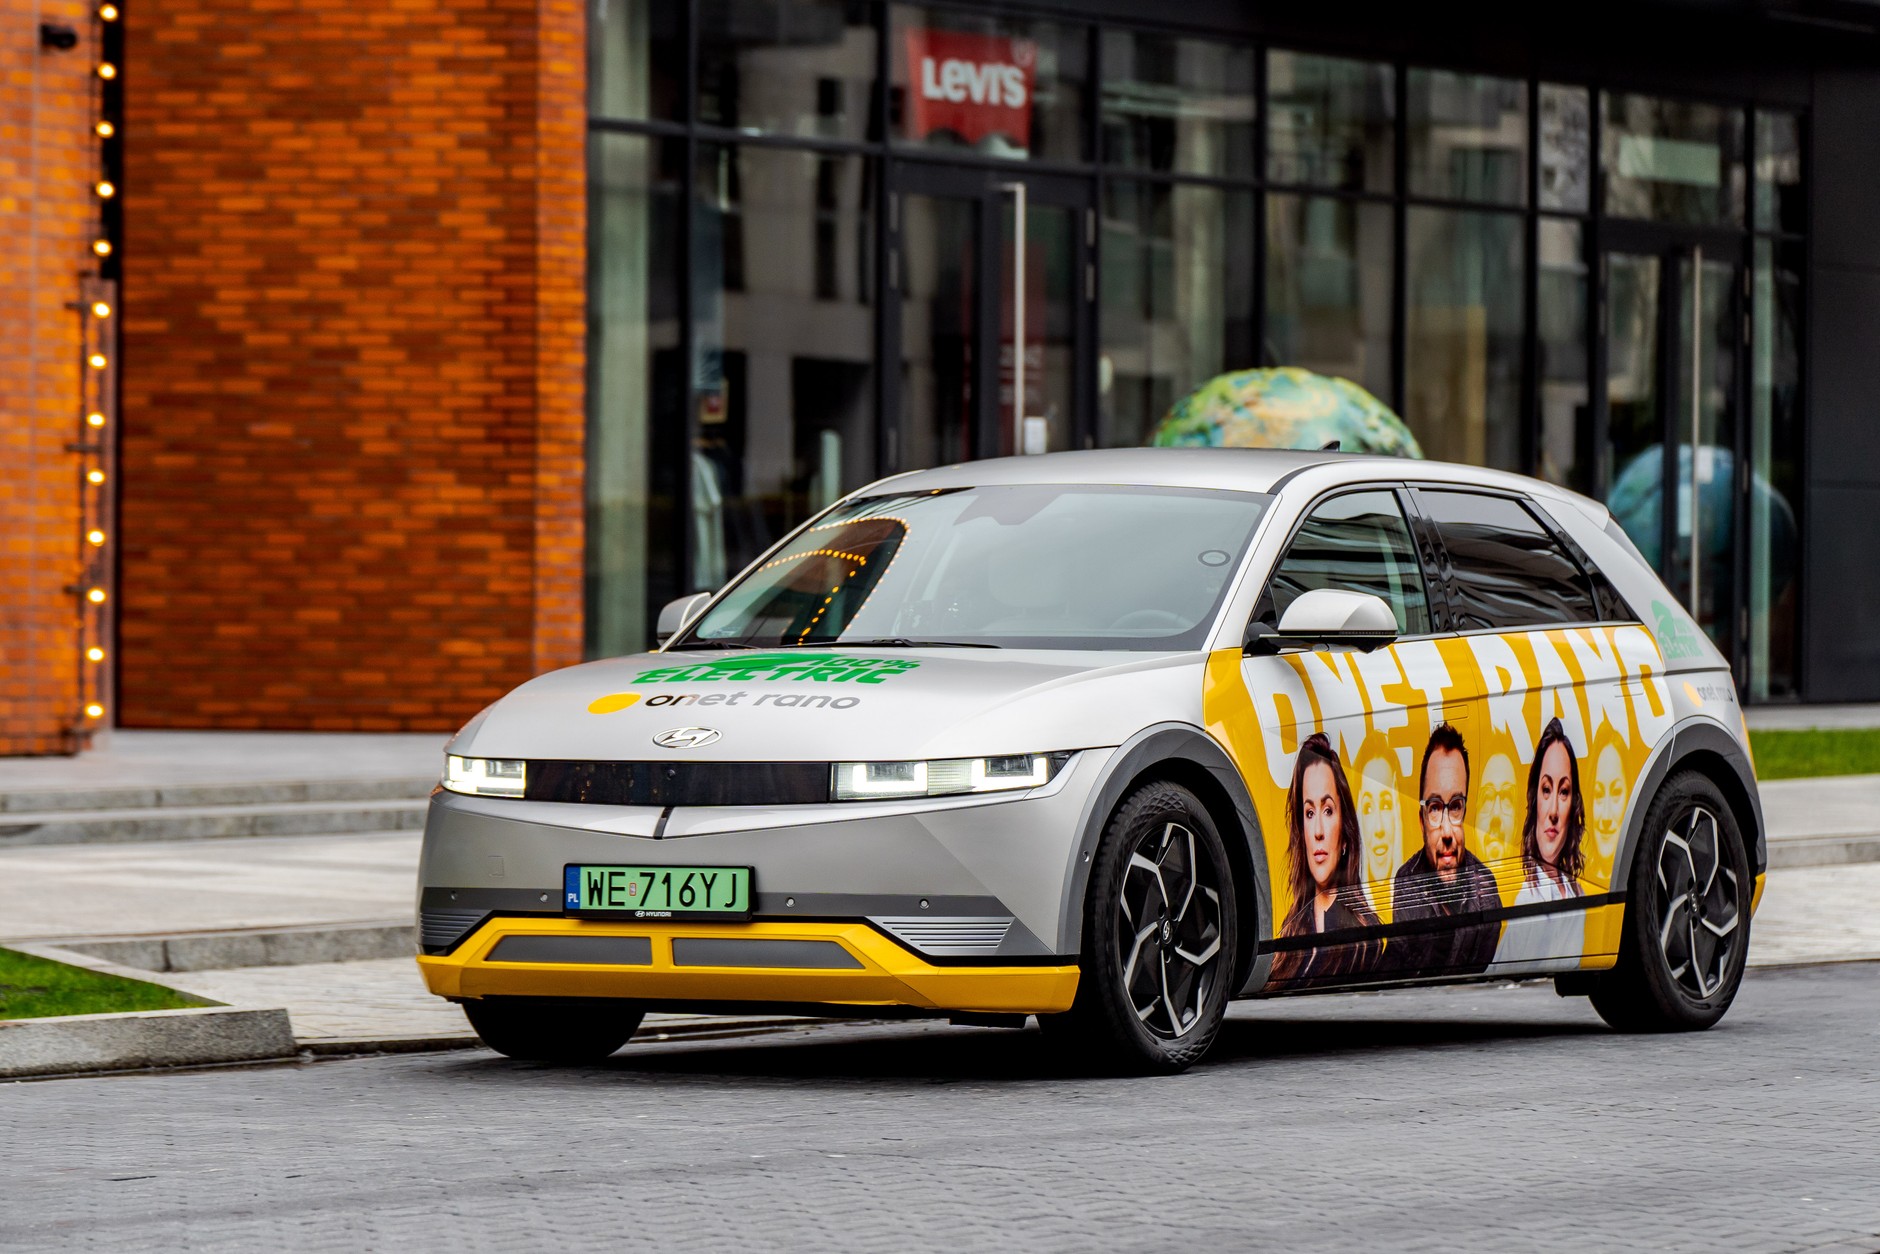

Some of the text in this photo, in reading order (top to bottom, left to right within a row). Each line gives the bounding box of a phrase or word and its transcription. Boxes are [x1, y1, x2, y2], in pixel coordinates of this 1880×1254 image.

[807, 658, 922, 669] 100%
[630, 664, 908, 684] ELECTRIC
[645, 691, 861, 710] onet rano
[1466, 626, 1675, 765] RANO
[568, 893, 579, 903] PL
[587, 871, 737, 908] WE 716YJ
